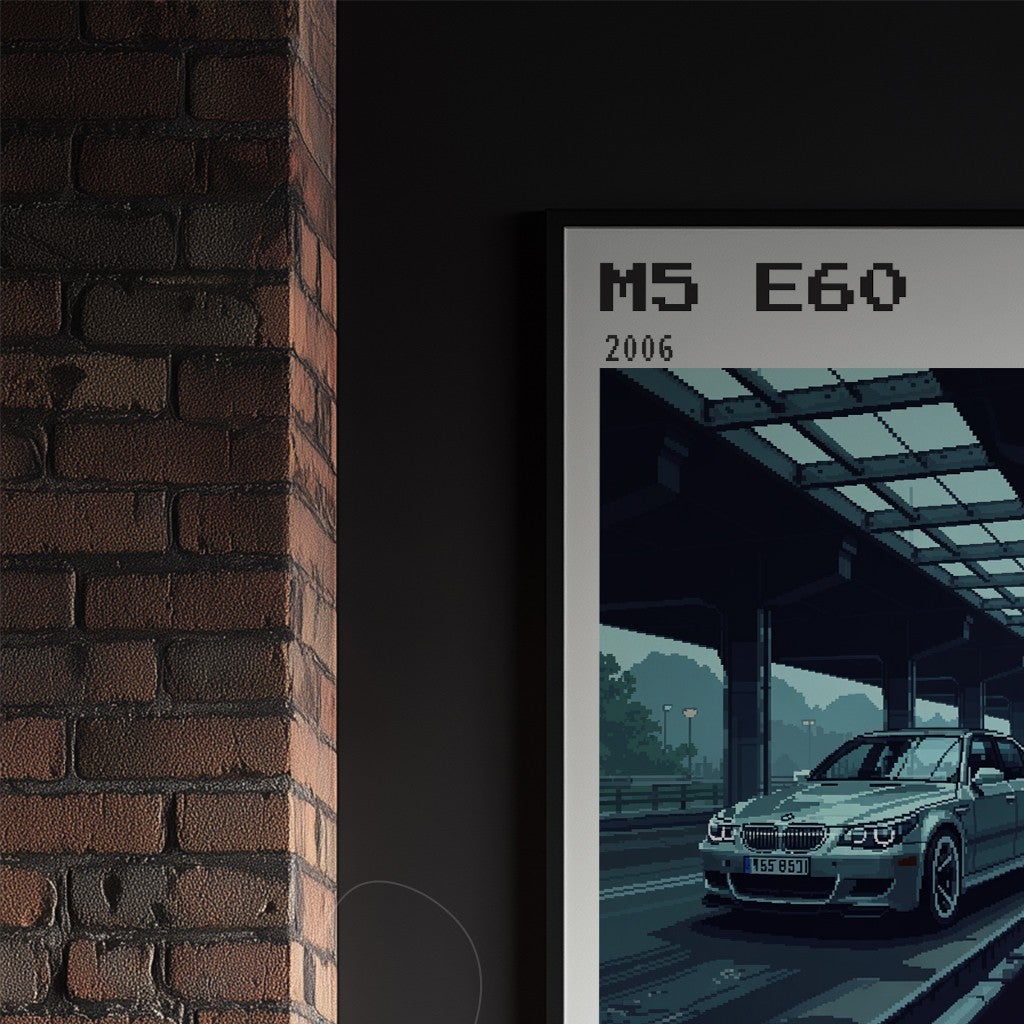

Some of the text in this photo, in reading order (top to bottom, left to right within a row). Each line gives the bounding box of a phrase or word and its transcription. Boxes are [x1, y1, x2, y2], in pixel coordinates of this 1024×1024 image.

[600, 262, 906, 312] M5 E60
[605, 335, 674, 362] 2006
